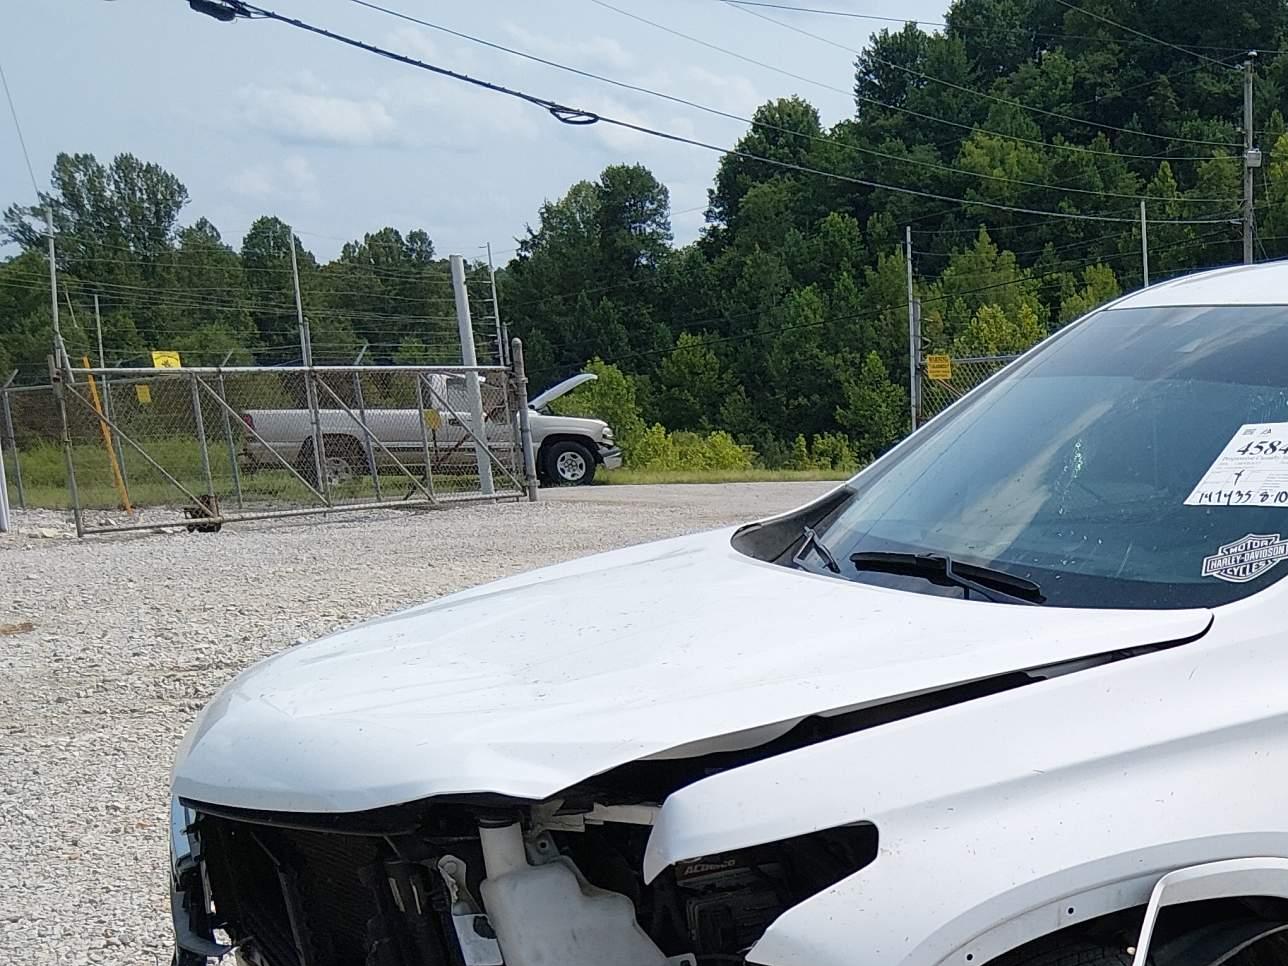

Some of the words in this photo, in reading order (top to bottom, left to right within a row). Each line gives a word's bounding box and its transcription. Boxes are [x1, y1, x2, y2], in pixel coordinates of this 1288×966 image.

[1229, 540, 1269, 554] MOTOR
[1210, 545, 1285, 570] HARLEY-DAVIDSON
[1226, 562, 1266, 577] CYCLES
